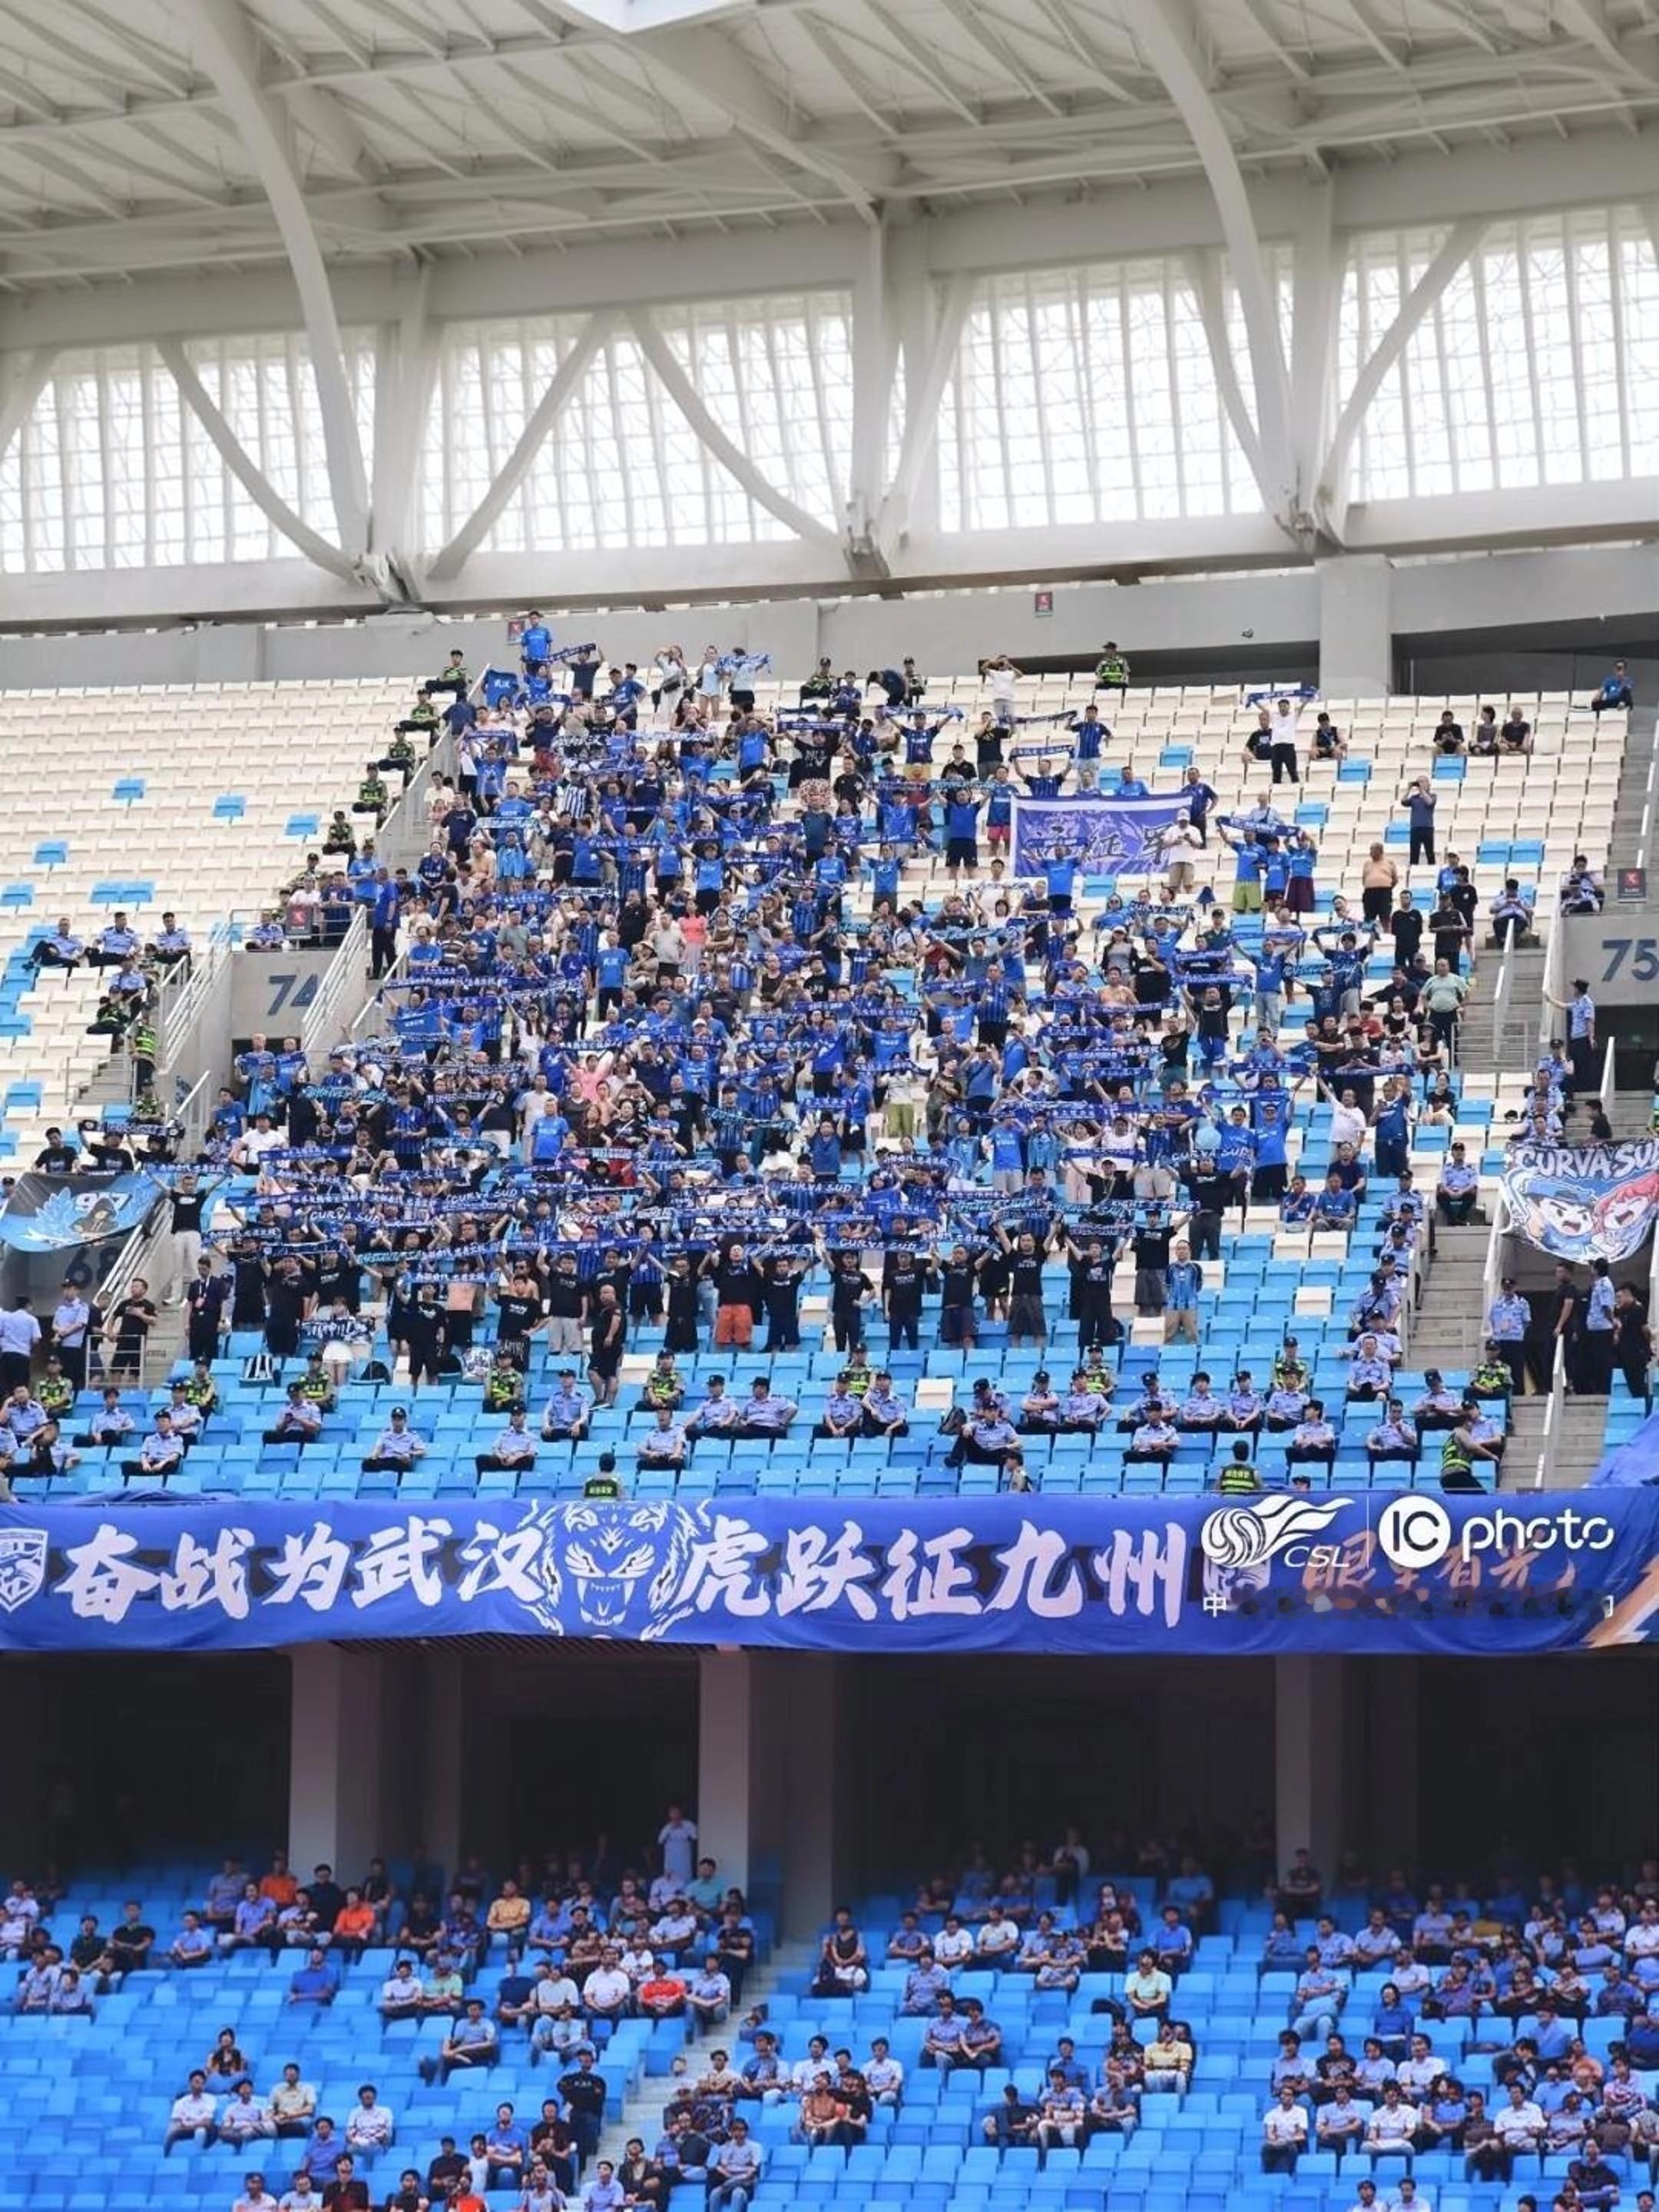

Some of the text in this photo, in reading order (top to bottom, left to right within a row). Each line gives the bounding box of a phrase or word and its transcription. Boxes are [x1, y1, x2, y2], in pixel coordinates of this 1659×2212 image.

[1601, 939, 1659, 982] 75
[268, 974, 317, 1015] 74
[1171, 1146, 1249, 1161] CURVA SUD
[1516, 1138, 1659, 1180] CURVA SU
[780, 1182, 853, 1193] CURVA SUD
[451, 1189, 518, 1204] CURVA SUD
[310, 1211, 352, 1221] CURVA
[839, 1238, 917, 1250] CURVA SUD
[54, 1515, 1186, 1628] 奋战为武汉 虎跃征九州
